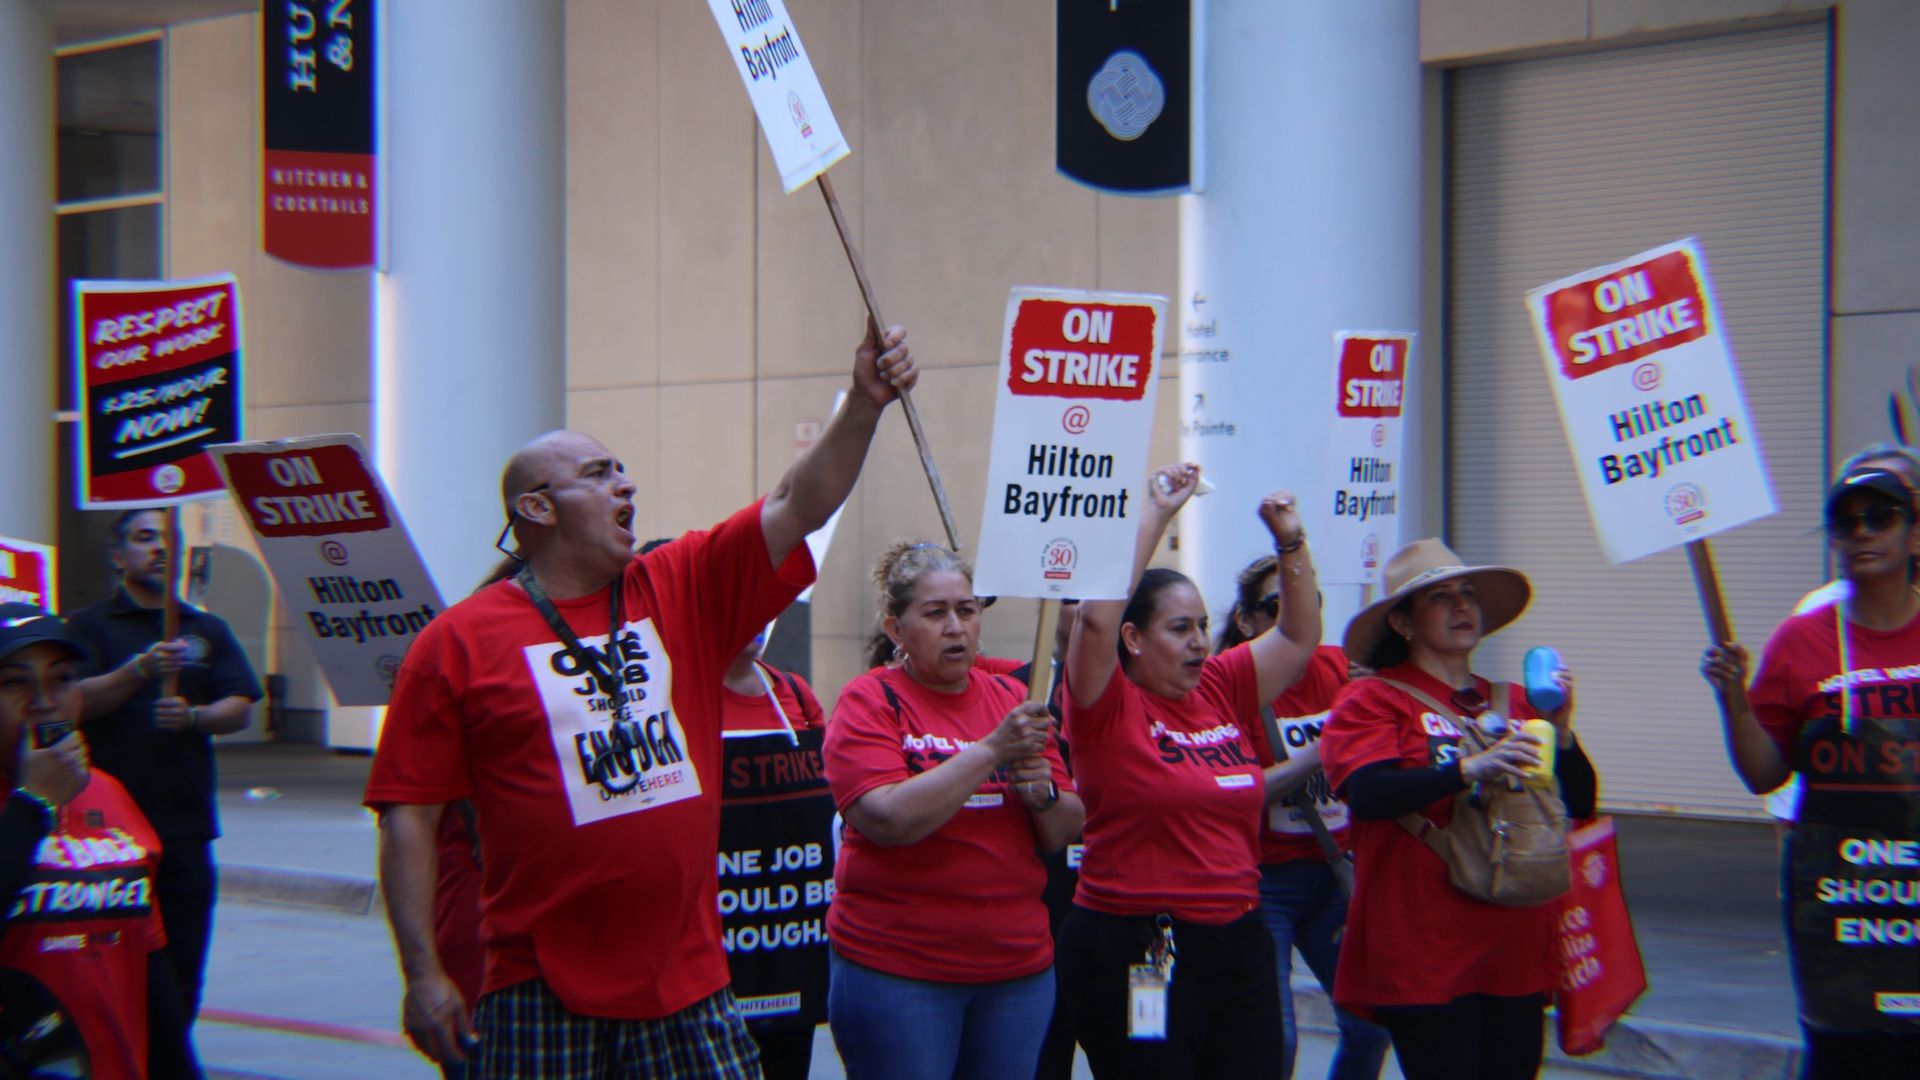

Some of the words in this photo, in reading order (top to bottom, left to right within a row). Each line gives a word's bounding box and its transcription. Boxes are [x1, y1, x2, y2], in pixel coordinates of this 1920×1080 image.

[327, 33, 353, 72] &
[740, 24, 799, 81] Bayfront
[274, 195, 368, 215] COCKTAILS
[1594, 271, 1654, 313] ON
[94, 291, 227, 345] RESPECT
[1062, 308, 1114, 344] ON
[1568, 298, 1697, 364] STRIKE
[96, 345, 150, 369] OUR
[153, 323, 226, 357] WORK
[1370, 344, 1393, 372] ON
[1021, 348, 1139, 388] STRIKE
[1633, 363, 1661, 391] @
[103, 367, 228, 415] $25/HOUR
[1344, 378, 1401, 407] STRIKE
[116, 398, 212, 443] NOW!
[1062, 405, 1090, 434] @
[1609, 394, 1706, 442] Hilton
[1028, 444, 1113, 478] Hilton
[1598, 417, 1740, 485] Bayfront
[268, 456, 323, 487] ON
[1350, 458, 1391, 482] Hilton
[253, 490, 377, 526] STRIKE
[1004, 483, 1128, 522] Bayfront
[1334, 489, 1396, 521] Bayfront
[320, 540, 350, 566] @
[1048, 548, 1072, 566] 30
[306, 576, 403, 604] Hilton
[306, 604, 436, 643] Bayfront
[903, 733, 954, 749] HOTEL
[1810, 740, 1865, 773] ON
[730, 750, 826, 788] STRIKE
[771, 843, 822, 872] JOB
[1839, 838, 1920, 866] ONE
